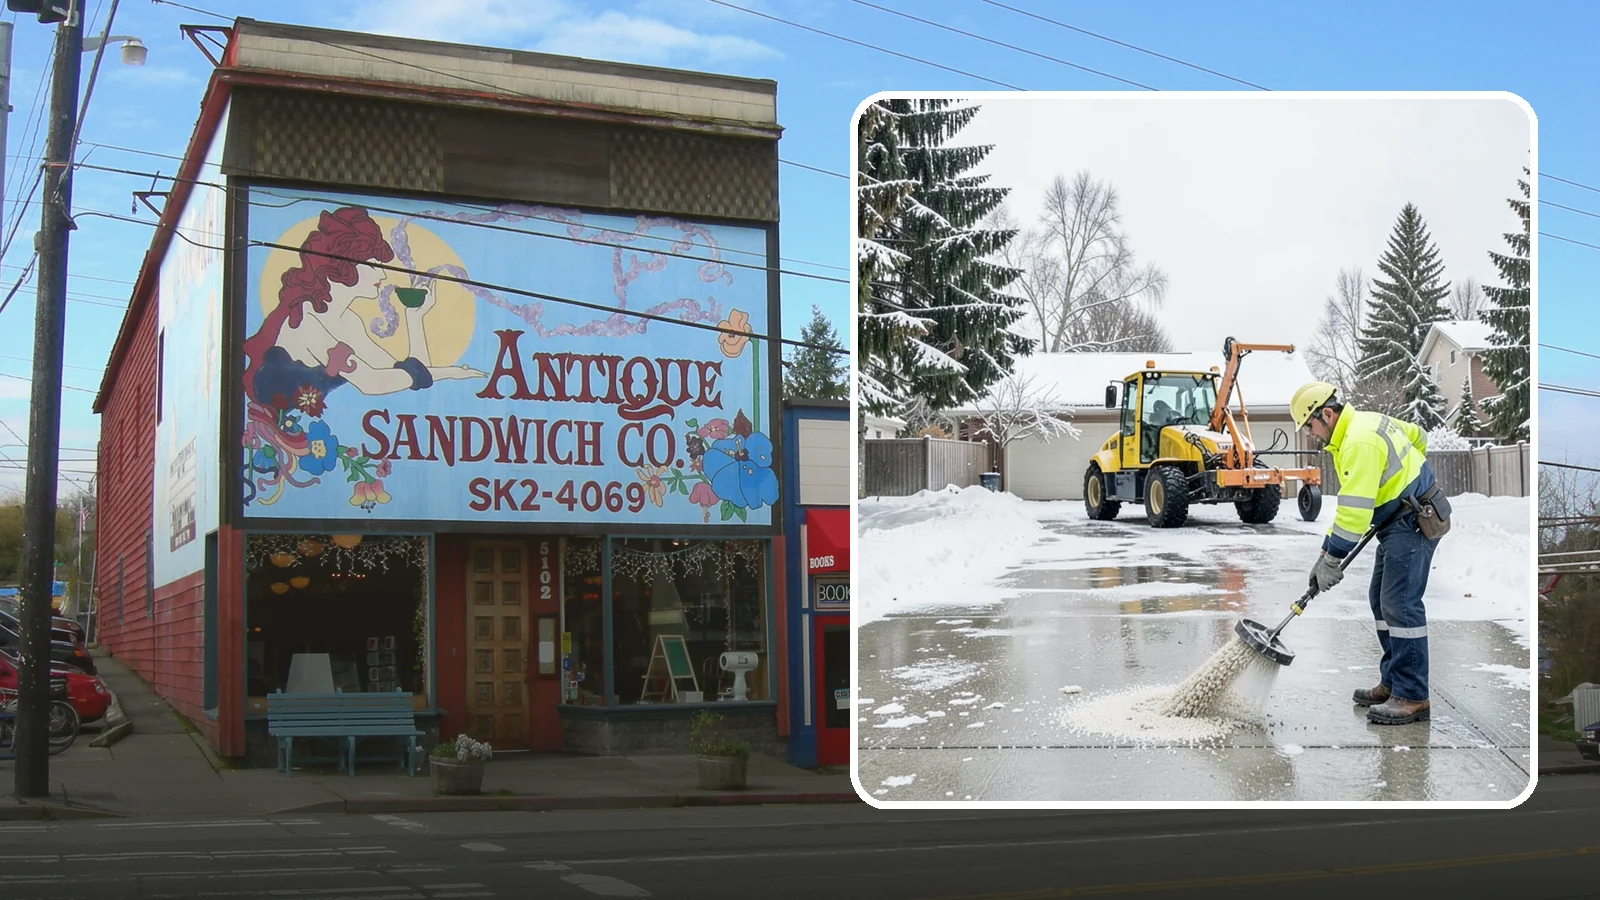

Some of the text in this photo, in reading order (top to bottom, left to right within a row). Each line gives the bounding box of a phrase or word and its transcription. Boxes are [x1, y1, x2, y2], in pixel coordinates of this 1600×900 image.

[475, 329, 724, 421] ANTIQUE
[361, 408, 685, 469] SANDWICH CO.
[468, 477, 645, 513] SK2-4069
[540, 542, 552, 600] 5102
[809, 555, 835, 569] BOOKS
